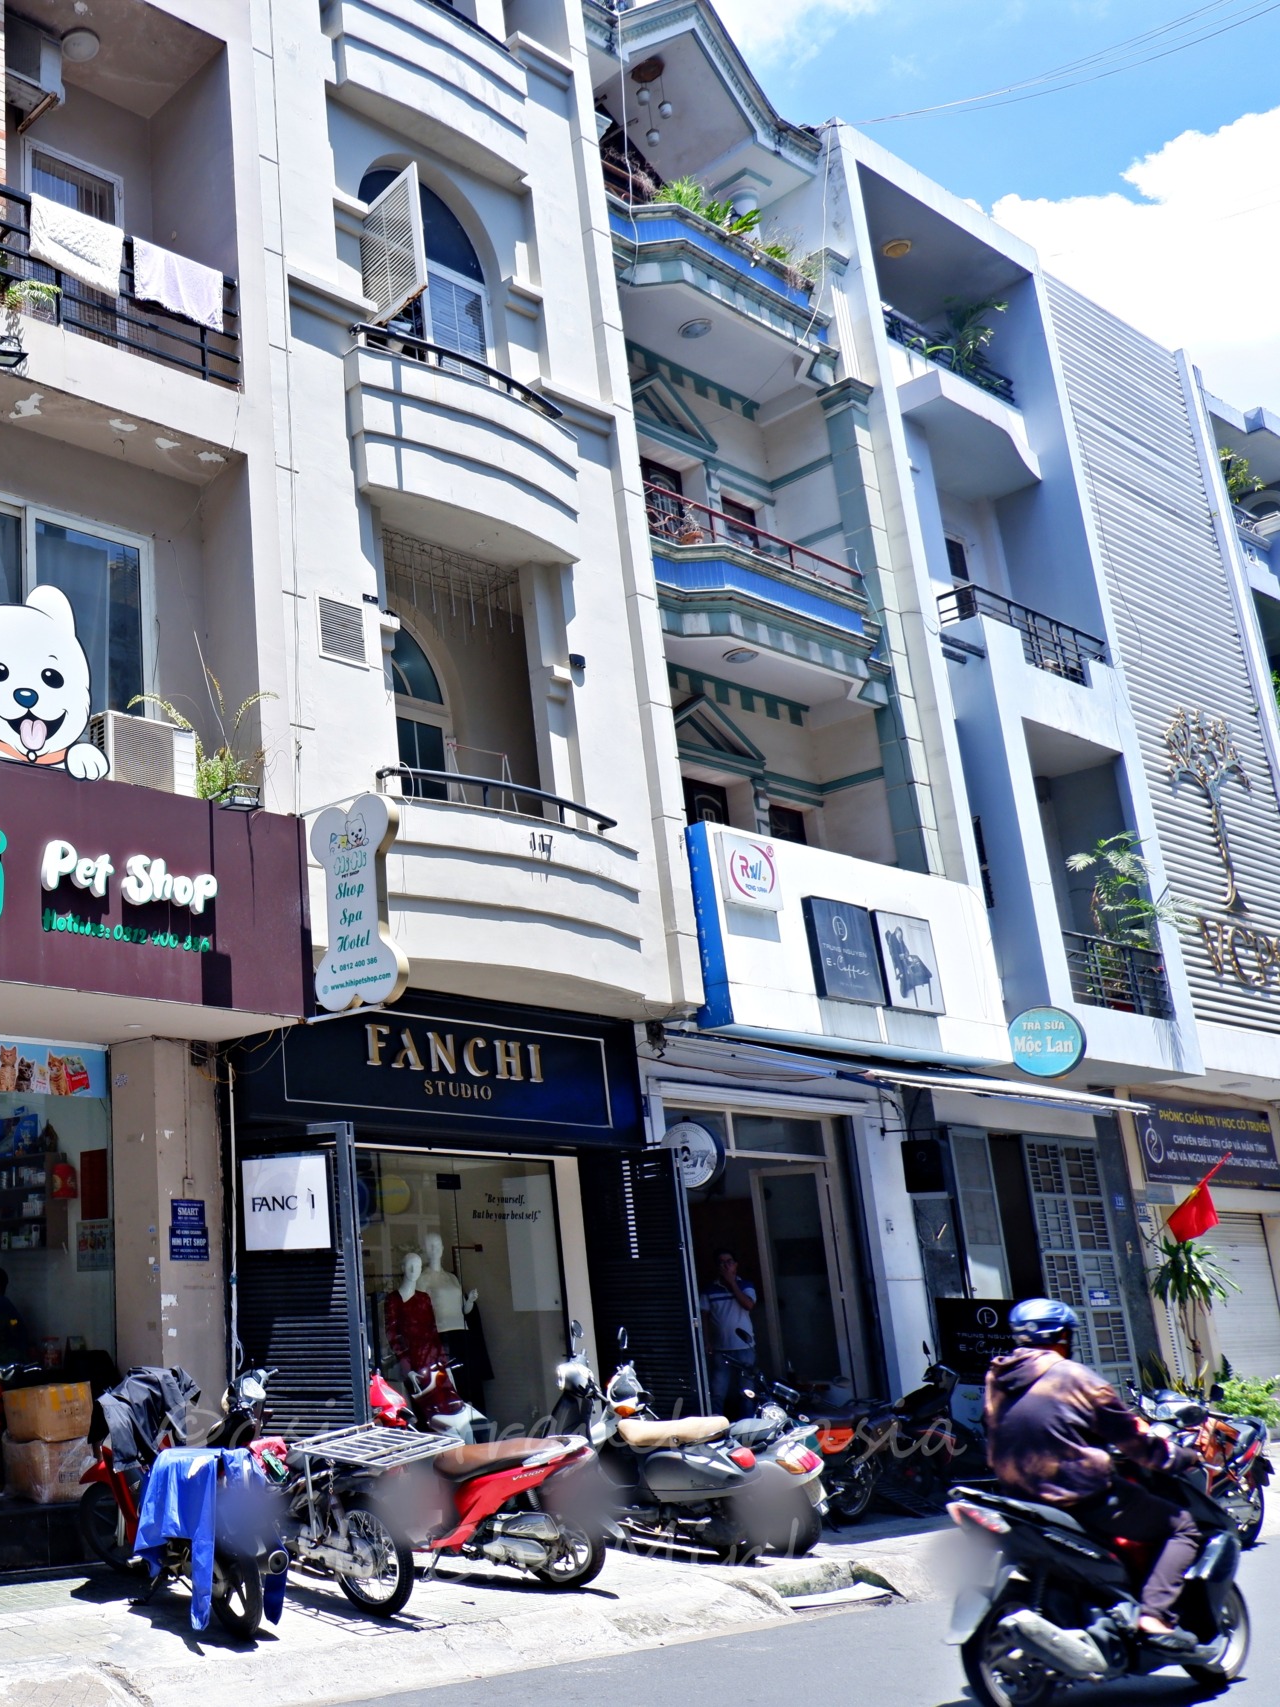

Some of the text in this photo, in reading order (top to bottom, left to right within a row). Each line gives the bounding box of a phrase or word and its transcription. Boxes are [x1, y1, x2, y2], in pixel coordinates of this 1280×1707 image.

[41, 840, 218, 915] Pet Shop
[335, 882, 365, 900] Shop
[340, 908, 363, 927] Spa
[337, 929, 371, 952] Hotel
[339, 956, 378, 971] 0812 400 386
[330, 972, 392, 991] www.hihipetshop.com
[1022, 1020, 1041, 1031] TRÀ
[365, 1023, 544, 1083] FANCHI
[1013, 1035, 1042, 1057] Mộc
[424, 1079, 492, 1101] STUDIO
[1216, 1117, 1222, 1126] Y
[177, 1207, 199, 1216] SMART
[472, 1209, 485, 1219] But
[485, 1209, 494, 1219] be
[494, 1212, 510, 1222] your
[510, 1210, 524, 1220] best
[183, 1238, 192, 1246] PET
[193, 1238, 207, 1246] SHOP
